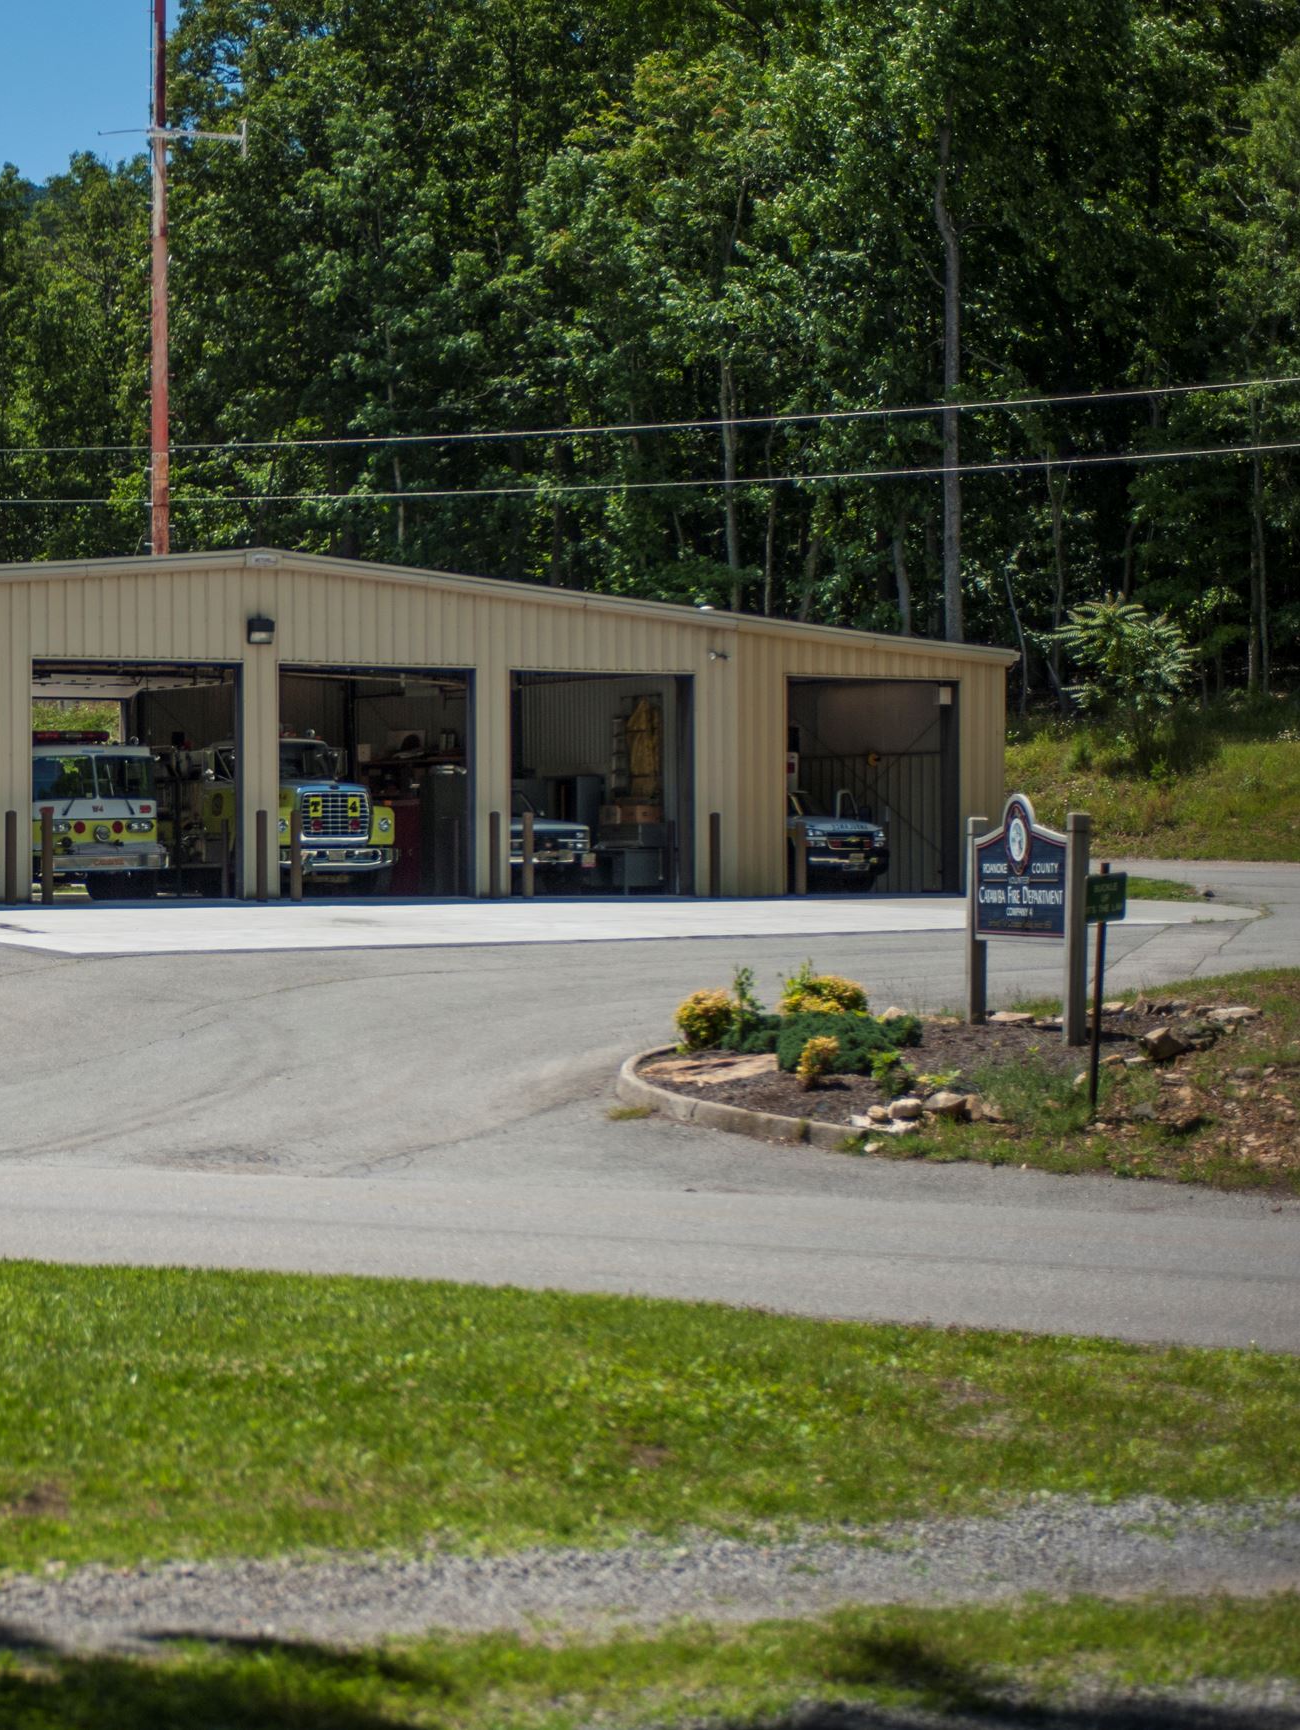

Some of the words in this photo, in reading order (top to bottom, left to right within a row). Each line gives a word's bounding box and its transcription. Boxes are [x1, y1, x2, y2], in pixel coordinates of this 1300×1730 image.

[348, 800, 358, 813] 4
[982, 863, 1008, 874] ROANOKE
[1031, 862, 1059, 874] COUNTY
[1007, 886, 1020, 904] FIRE
[1022, 886, 1064, 905] DEPARTMENT
